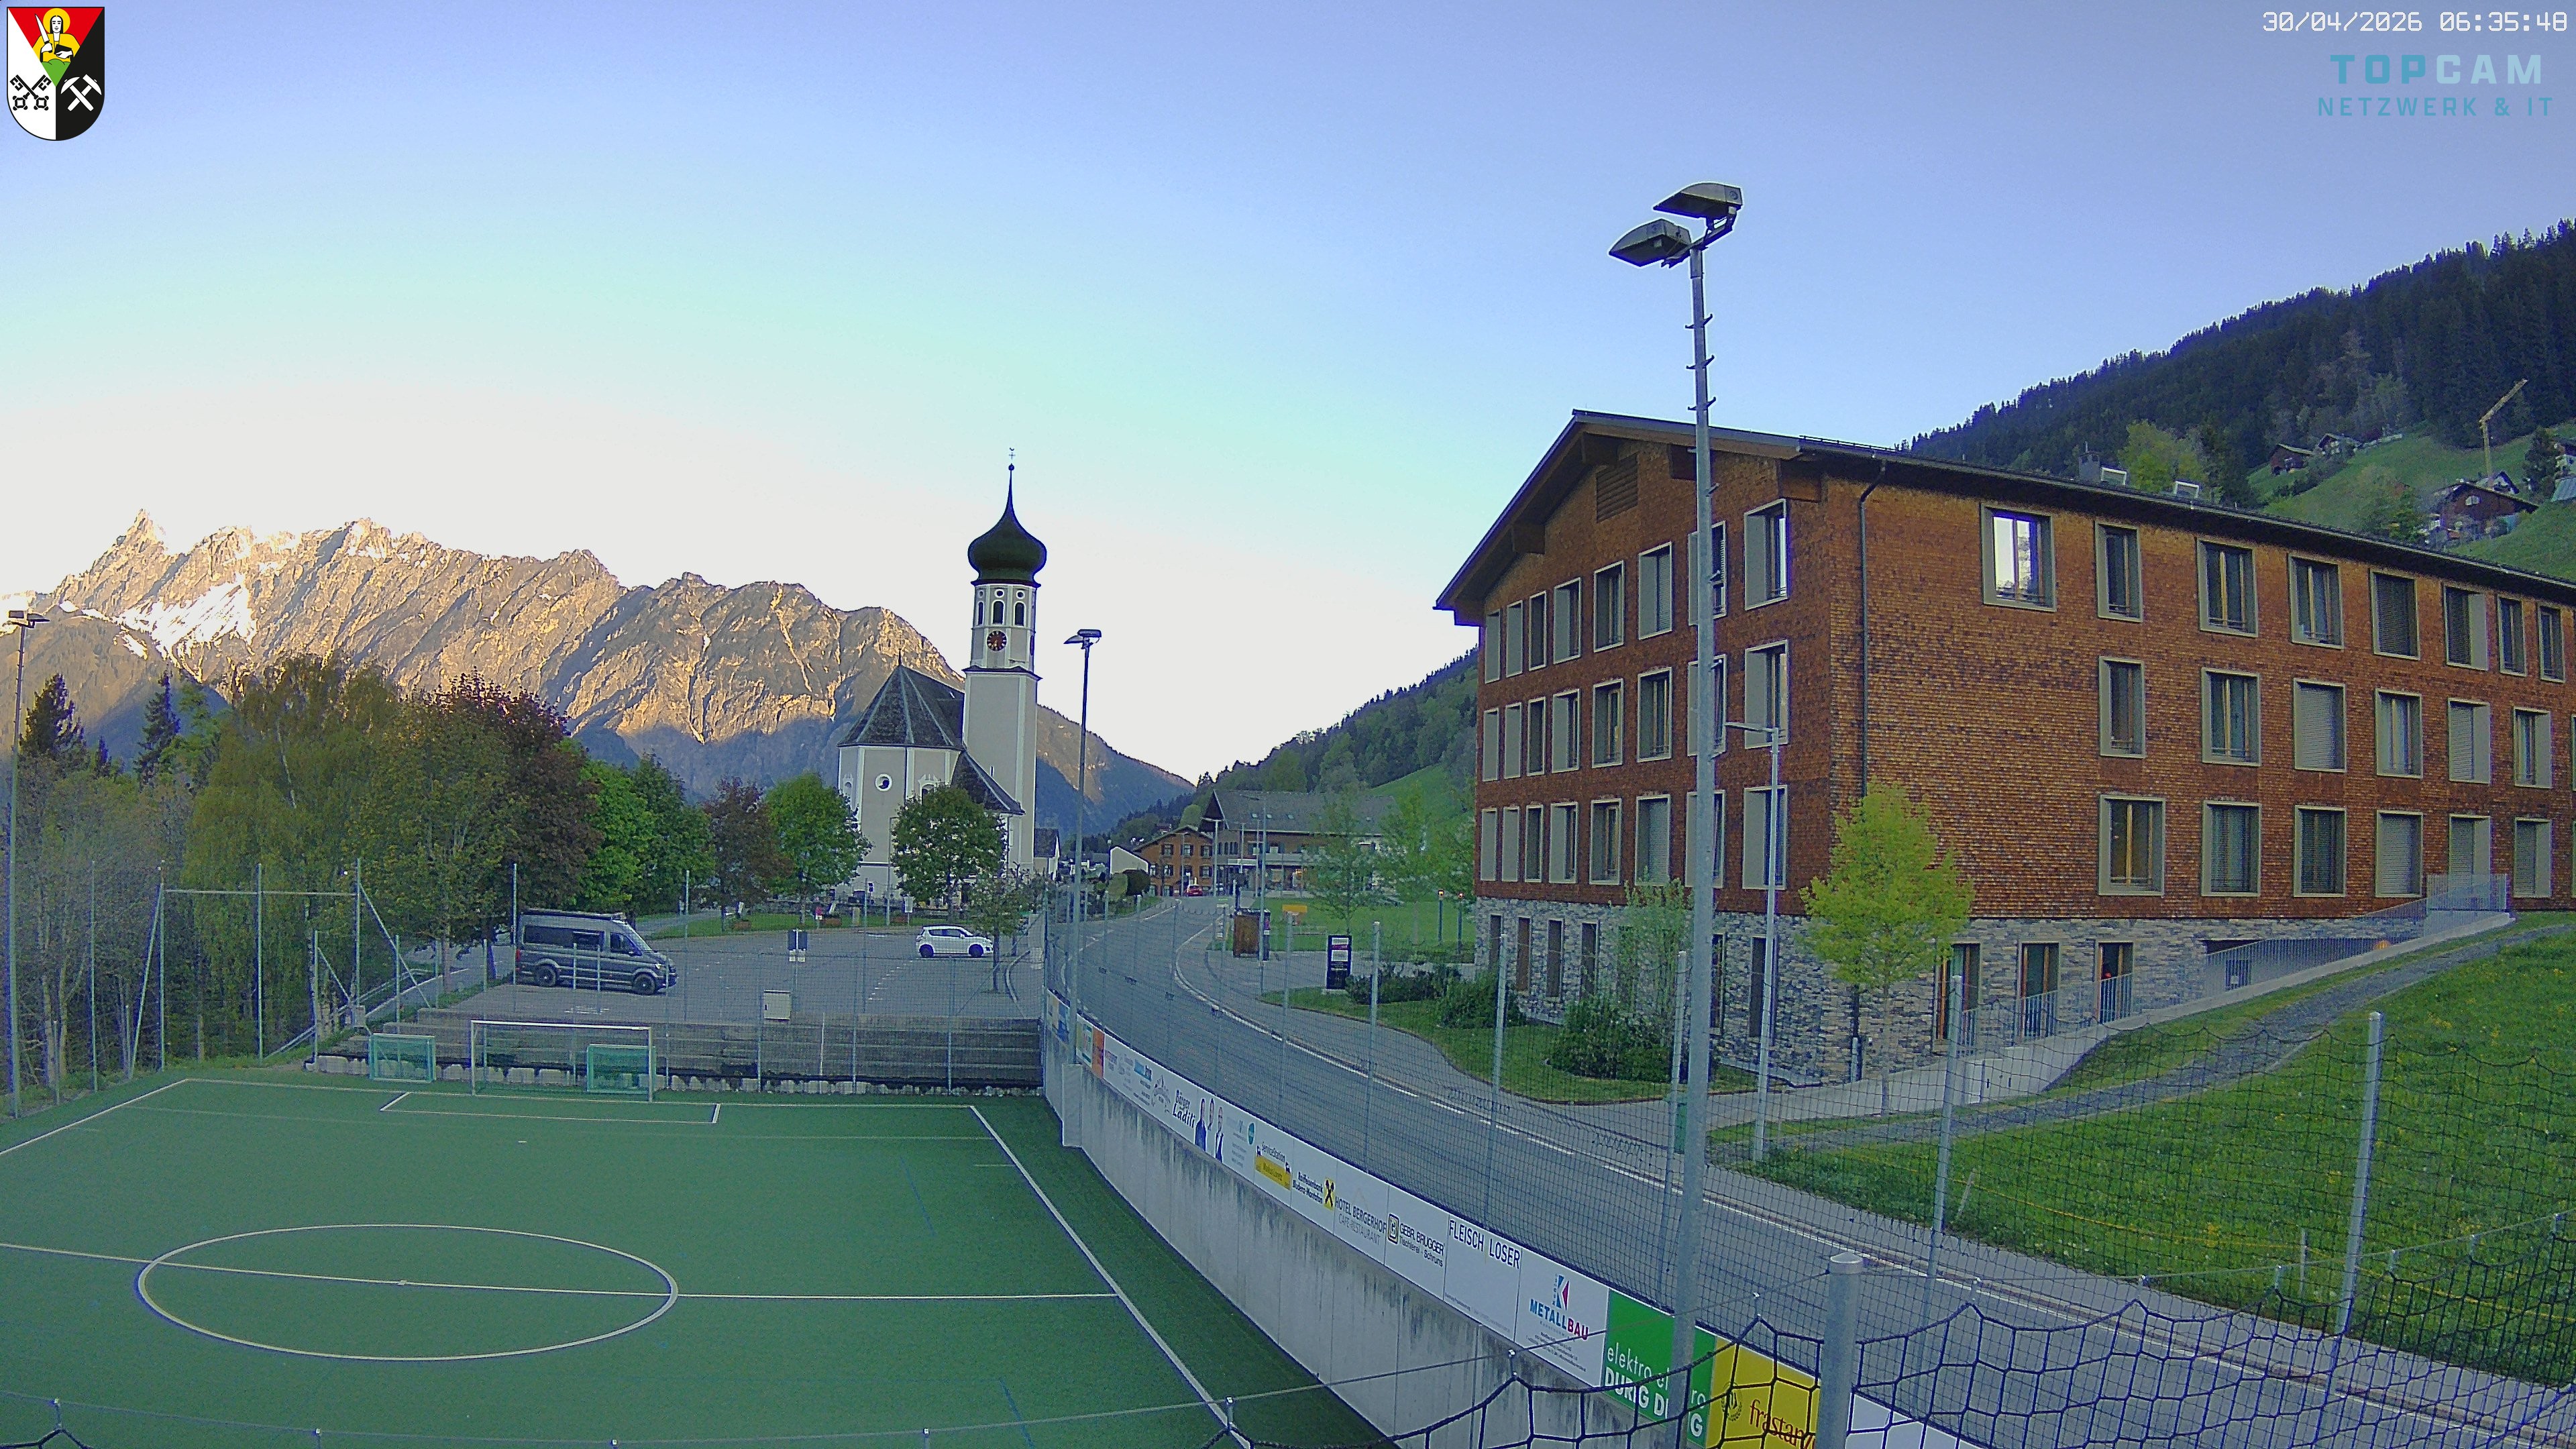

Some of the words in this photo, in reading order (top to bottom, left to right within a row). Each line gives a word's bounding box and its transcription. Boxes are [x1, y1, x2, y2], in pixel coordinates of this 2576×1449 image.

[1298, 1171, 1323, 1193] Raiffeisenbank
[1335, 1196, 1351, 1216] HOTEL
[1352, 1205, 1387, 1234] BERGERHOF
[1399, 1235, 1419, 1254] Tischlerei
[1424, 1249, 1443, 1267] Schruns
[1416, 1231, 1444, 1256] BRUGGER
[1449, 1220, 1485, 1252] FLEISCH
[1489, 1238, 1521, 1269] LOSER
[1529, 1298, 1589, 1340] METALLBAU
[1607, 1342, 1652, 1379] elektro
